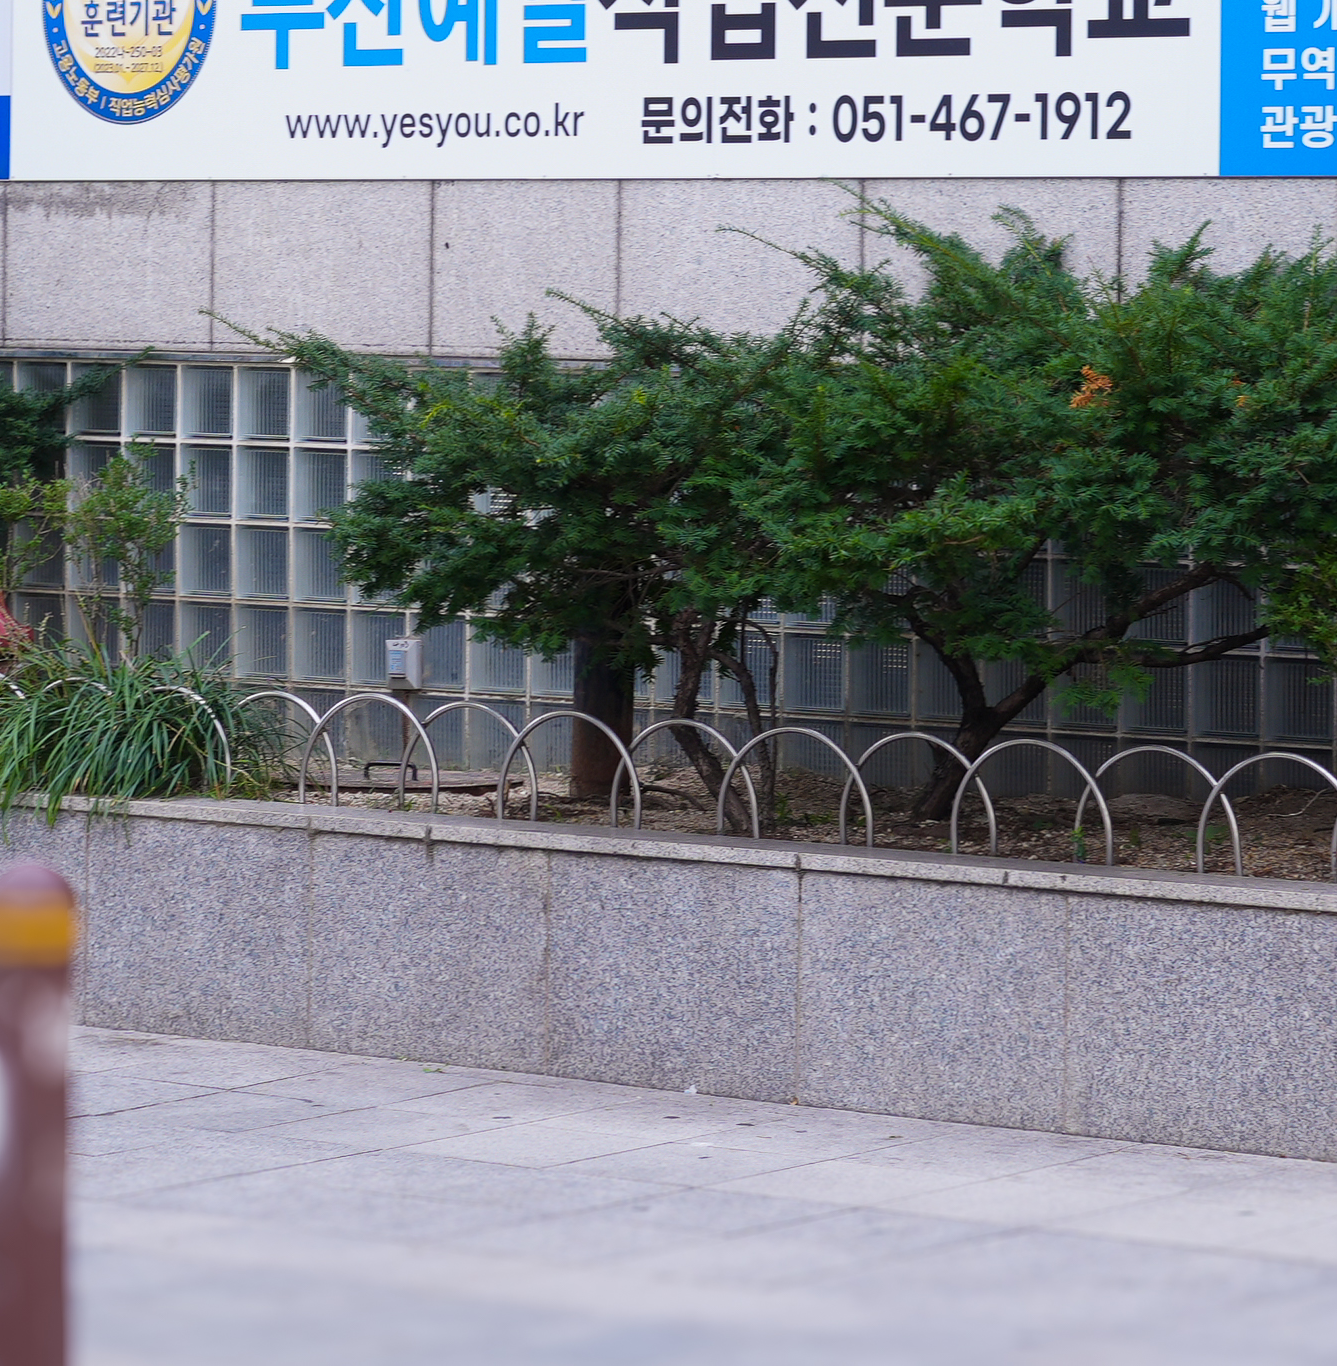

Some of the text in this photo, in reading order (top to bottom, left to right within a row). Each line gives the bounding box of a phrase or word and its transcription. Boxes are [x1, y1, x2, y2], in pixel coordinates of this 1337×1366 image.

[52, 36, 207, 117] 고용노동부 직업능력심사평가원
[285, 102, 585, 149] www.yesyou.co.kr
[641, 95, 795, 145] 문의전화
[832, 90, 1132, 143] 051-467-1912
